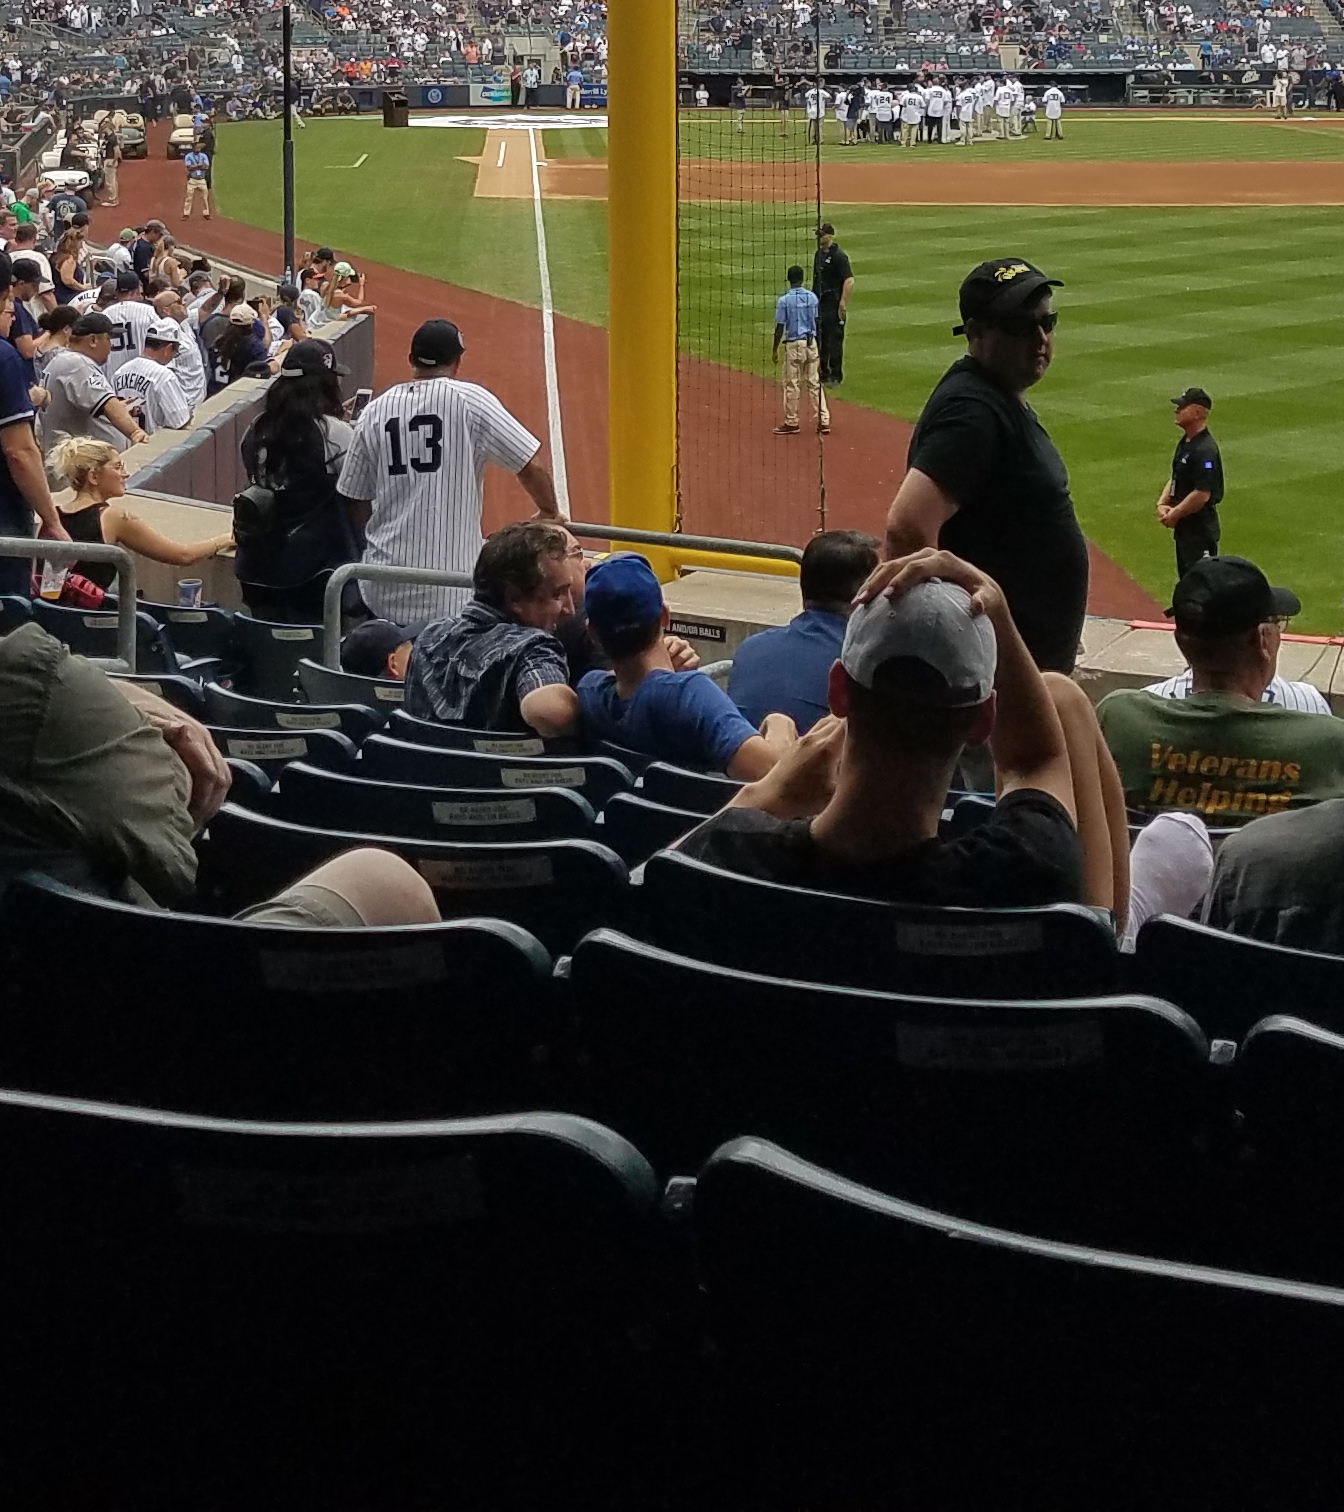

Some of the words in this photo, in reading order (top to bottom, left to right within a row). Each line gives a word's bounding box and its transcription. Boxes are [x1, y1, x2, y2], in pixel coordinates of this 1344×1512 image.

[116, 373, 151, 397] EIXEIRA
[384, 414, 444, 476] 13
[671, 622, 697, 635] AND/OR
[699, 626, 721, 639] BALLS
[1150, 743, 1301, 782] Veterans
[1150, 778, 1293, 815] Helping
